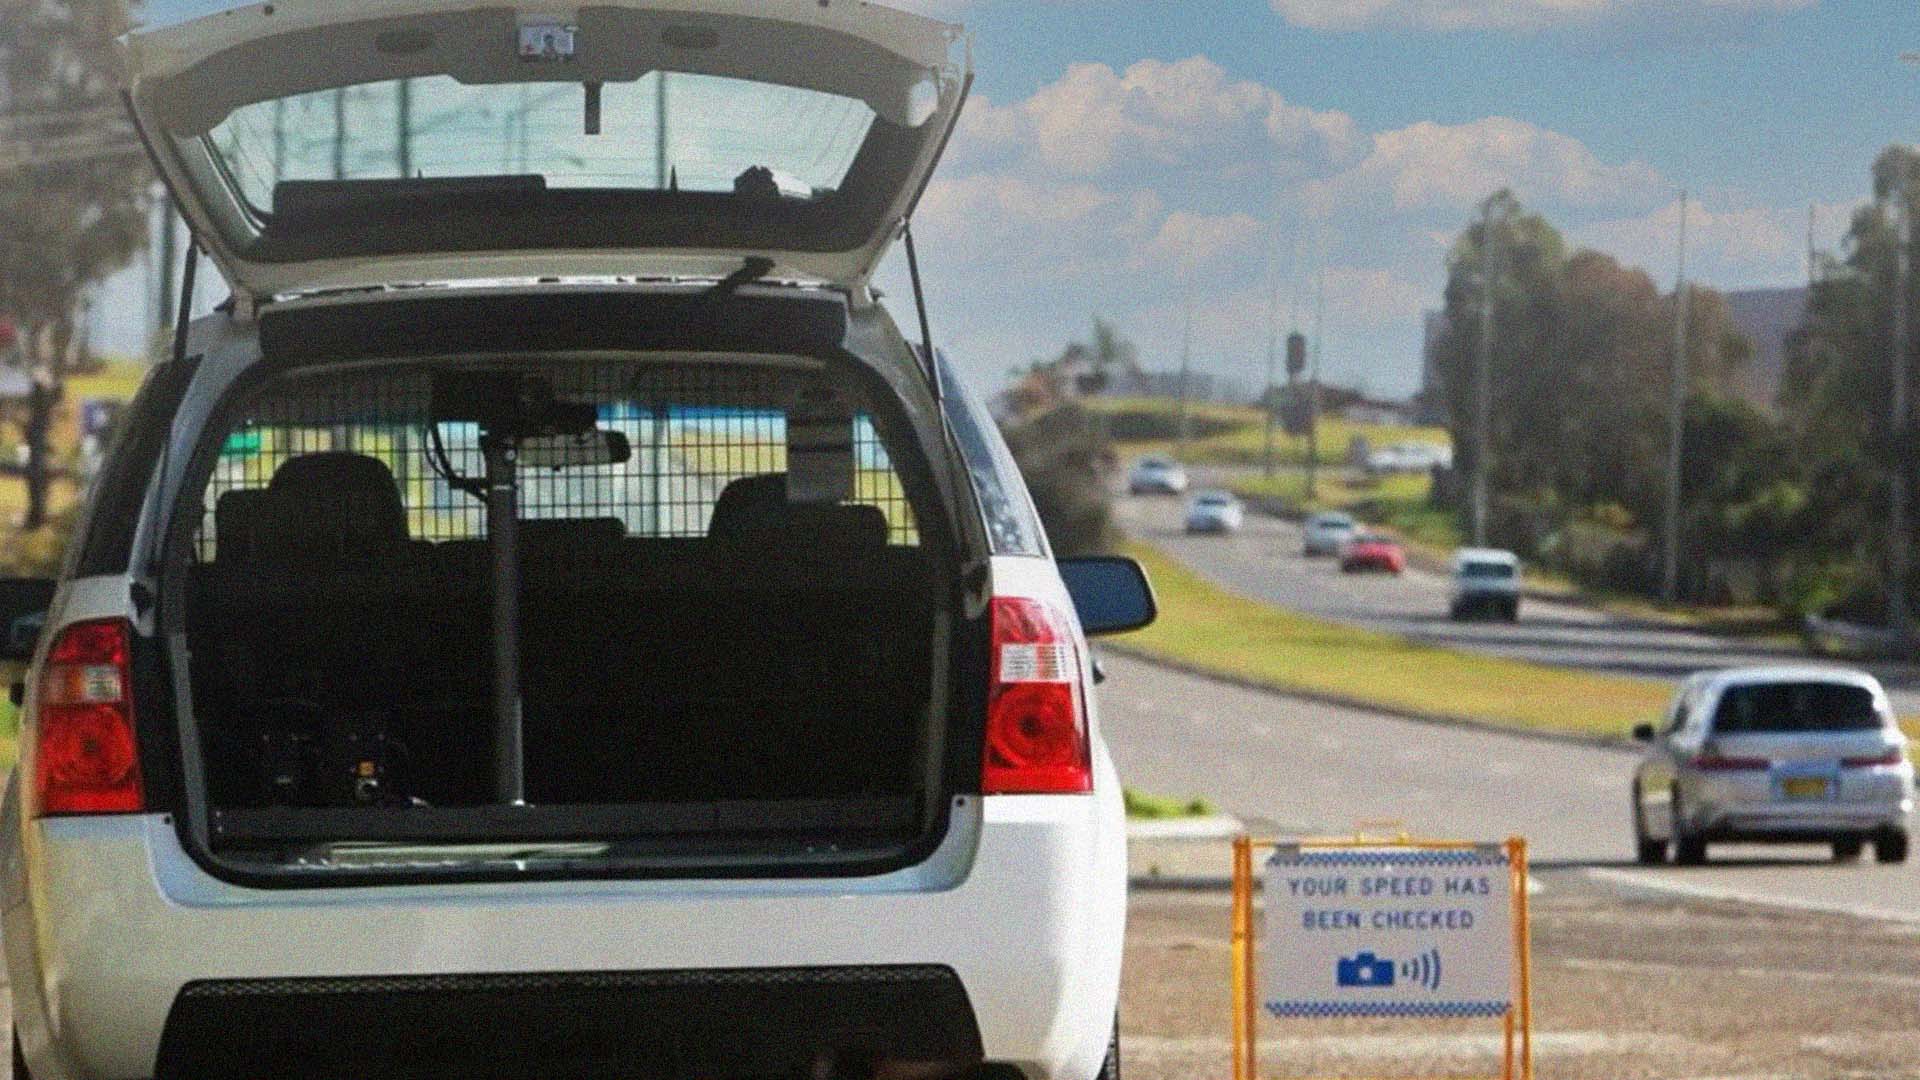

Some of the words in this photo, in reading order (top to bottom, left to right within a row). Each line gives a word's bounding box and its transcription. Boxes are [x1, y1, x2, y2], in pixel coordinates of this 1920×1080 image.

[1288, 877, 1347, 896] YOUR
[1361, 877, 1433, 895] SPEED
[1445, 877, 1490, 895] HAS
[1303, 910, 1360, 929] BEEN
[1372, 910, 1474, 929] CHECKED
